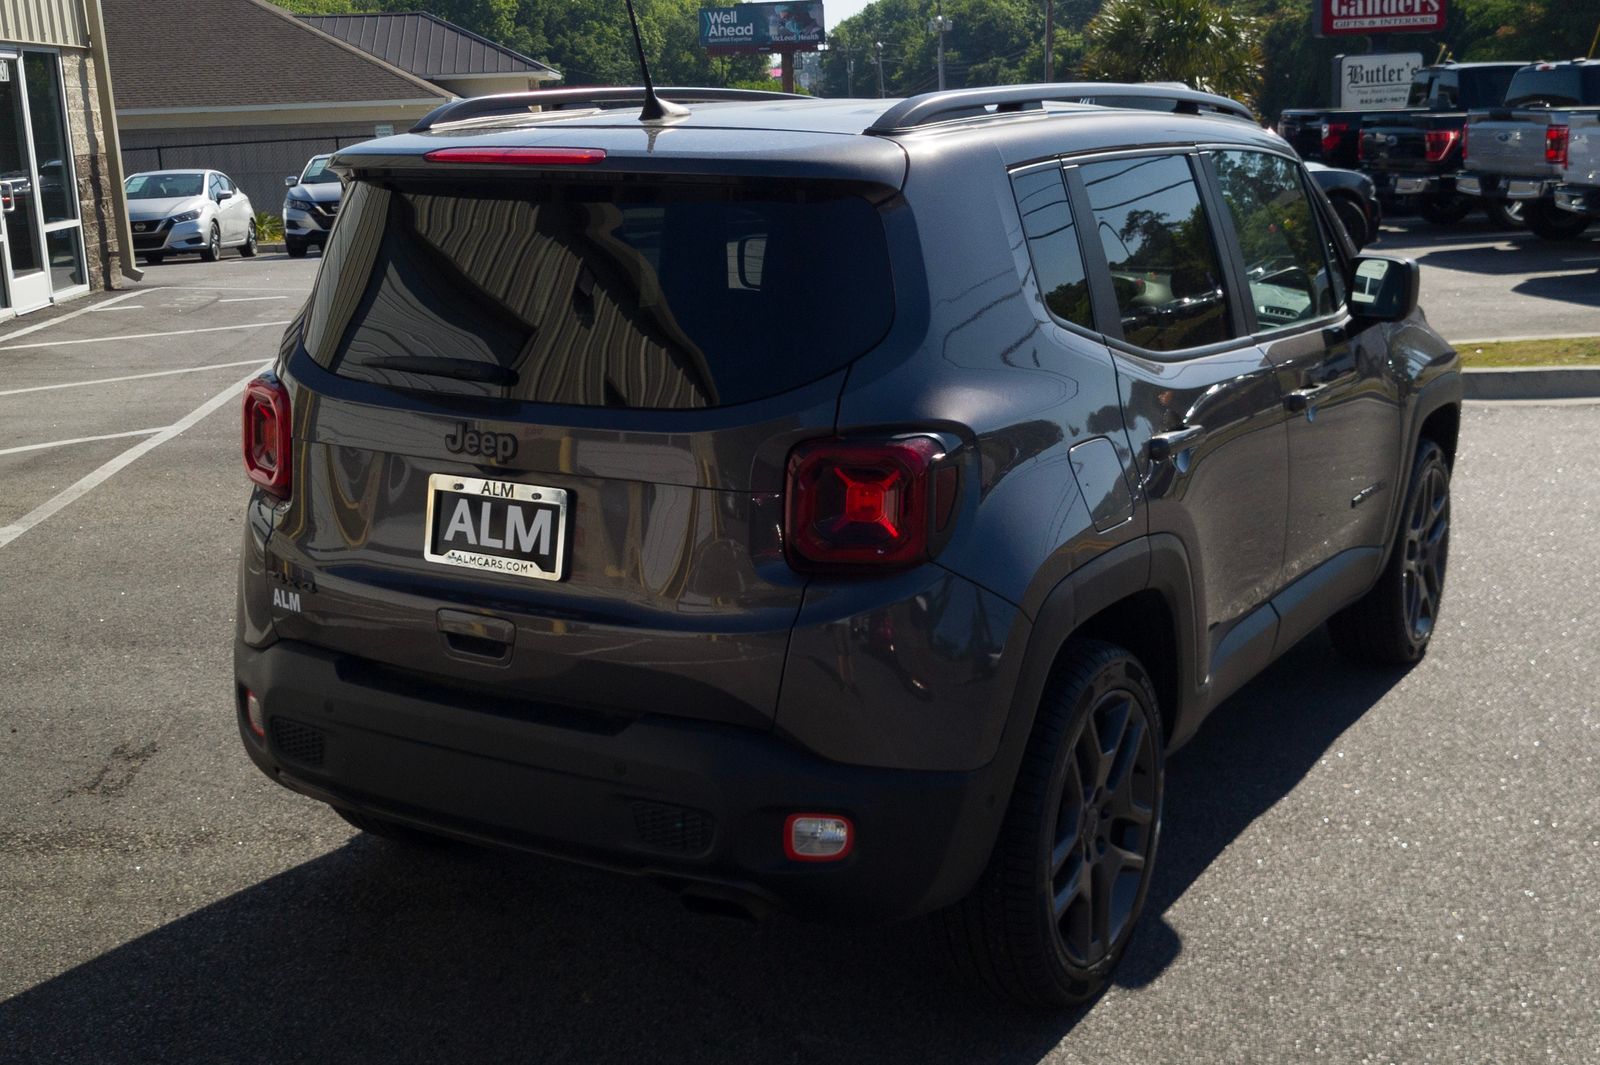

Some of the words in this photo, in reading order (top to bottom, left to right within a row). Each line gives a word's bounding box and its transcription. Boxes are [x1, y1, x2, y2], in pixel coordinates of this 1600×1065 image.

[708, 11, 737, 24] Well
[1334, 20, 1365, 28] GIFTS
[1380, 16, 1436, 25] INTERIORS
[708, 23, 753, 37] Ahead
[445, 422, 518, 464] Jeep
[480, 481, 515, 498] ALM
[443, 498, 553, 556] ALM
[456, 553, 528, 573] ALMCARS.COM
[273, 587, 301, 613] ALM
